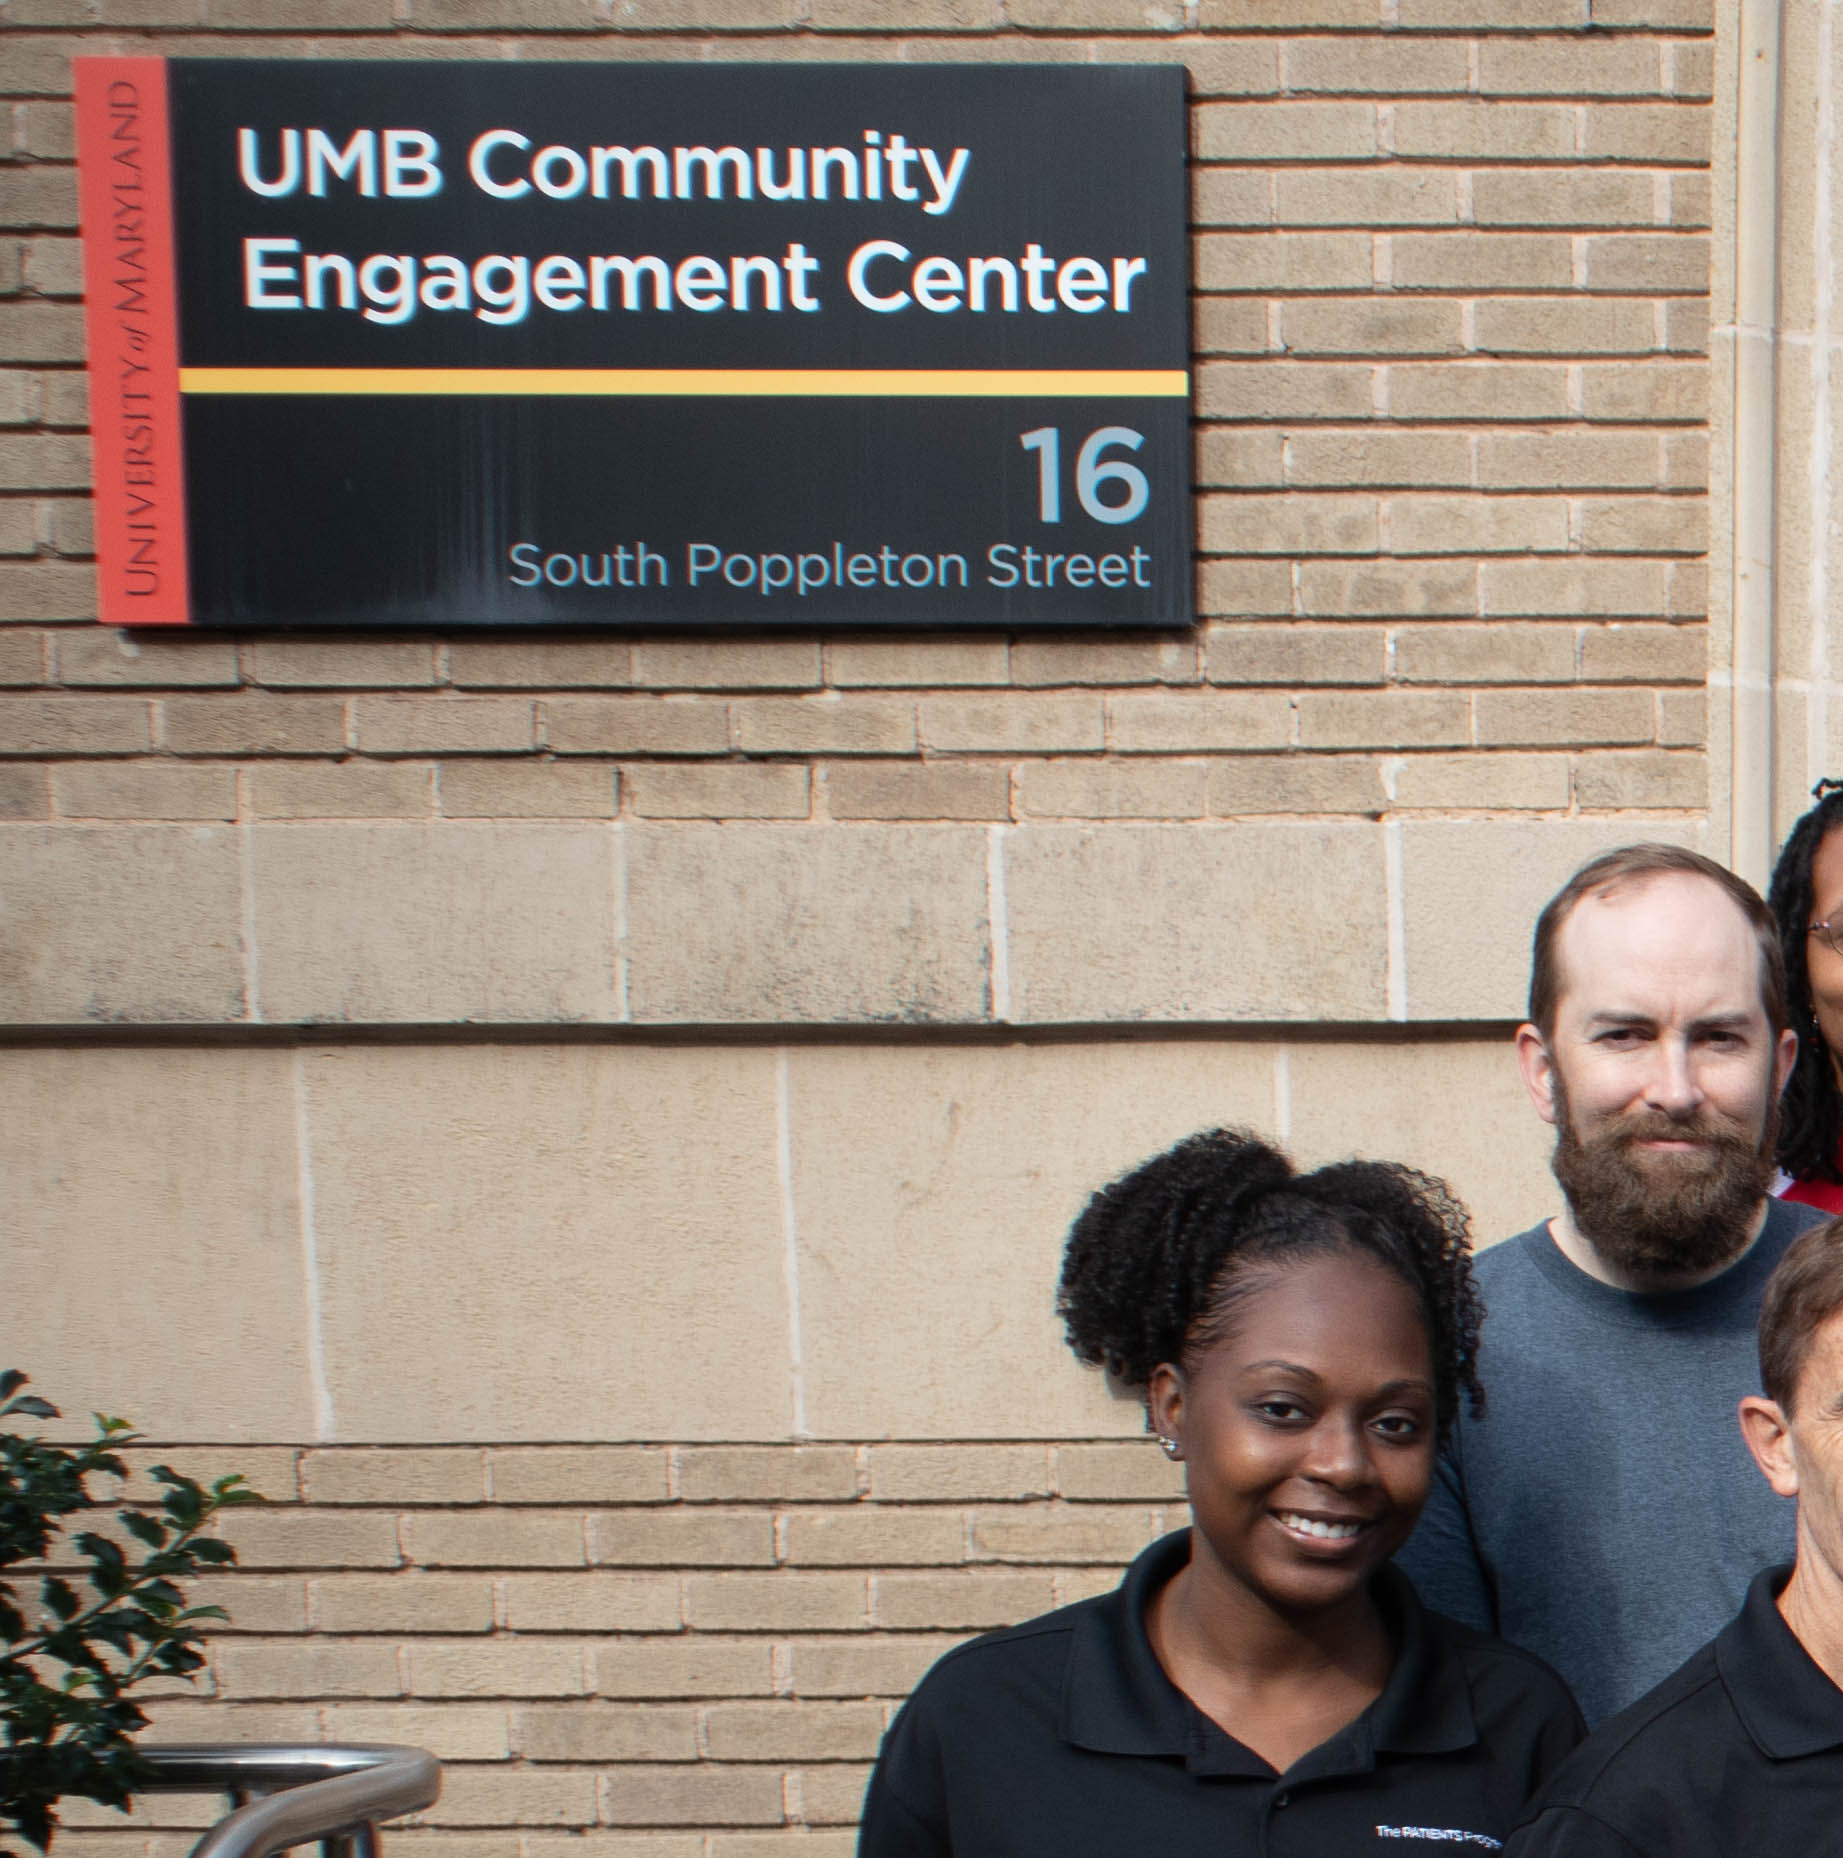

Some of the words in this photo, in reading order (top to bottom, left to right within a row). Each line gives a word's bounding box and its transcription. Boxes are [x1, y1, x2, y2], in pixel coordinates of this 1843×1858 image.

[108, 81, 148, 312] MARYLAND
[237, 128, 443, 197] UMB
[467, 128, 970, 215] Community
[243, 237, 821, 325] Engagement
[846, 240, 1147, 313] Center
[119, 321, 150, 352] of
[119, 355, 158, 597] UNIVERSITY
[1020, 426, 1150, 524] 16
[509, 542, 668, 586] South
[688, 542, 967, 595] Poppleton
[987, 544, 1152, 587] Street
[1376, 1825, 1401, 1838] The
[1402, 1826, 1463, 1841] PATIENTS
